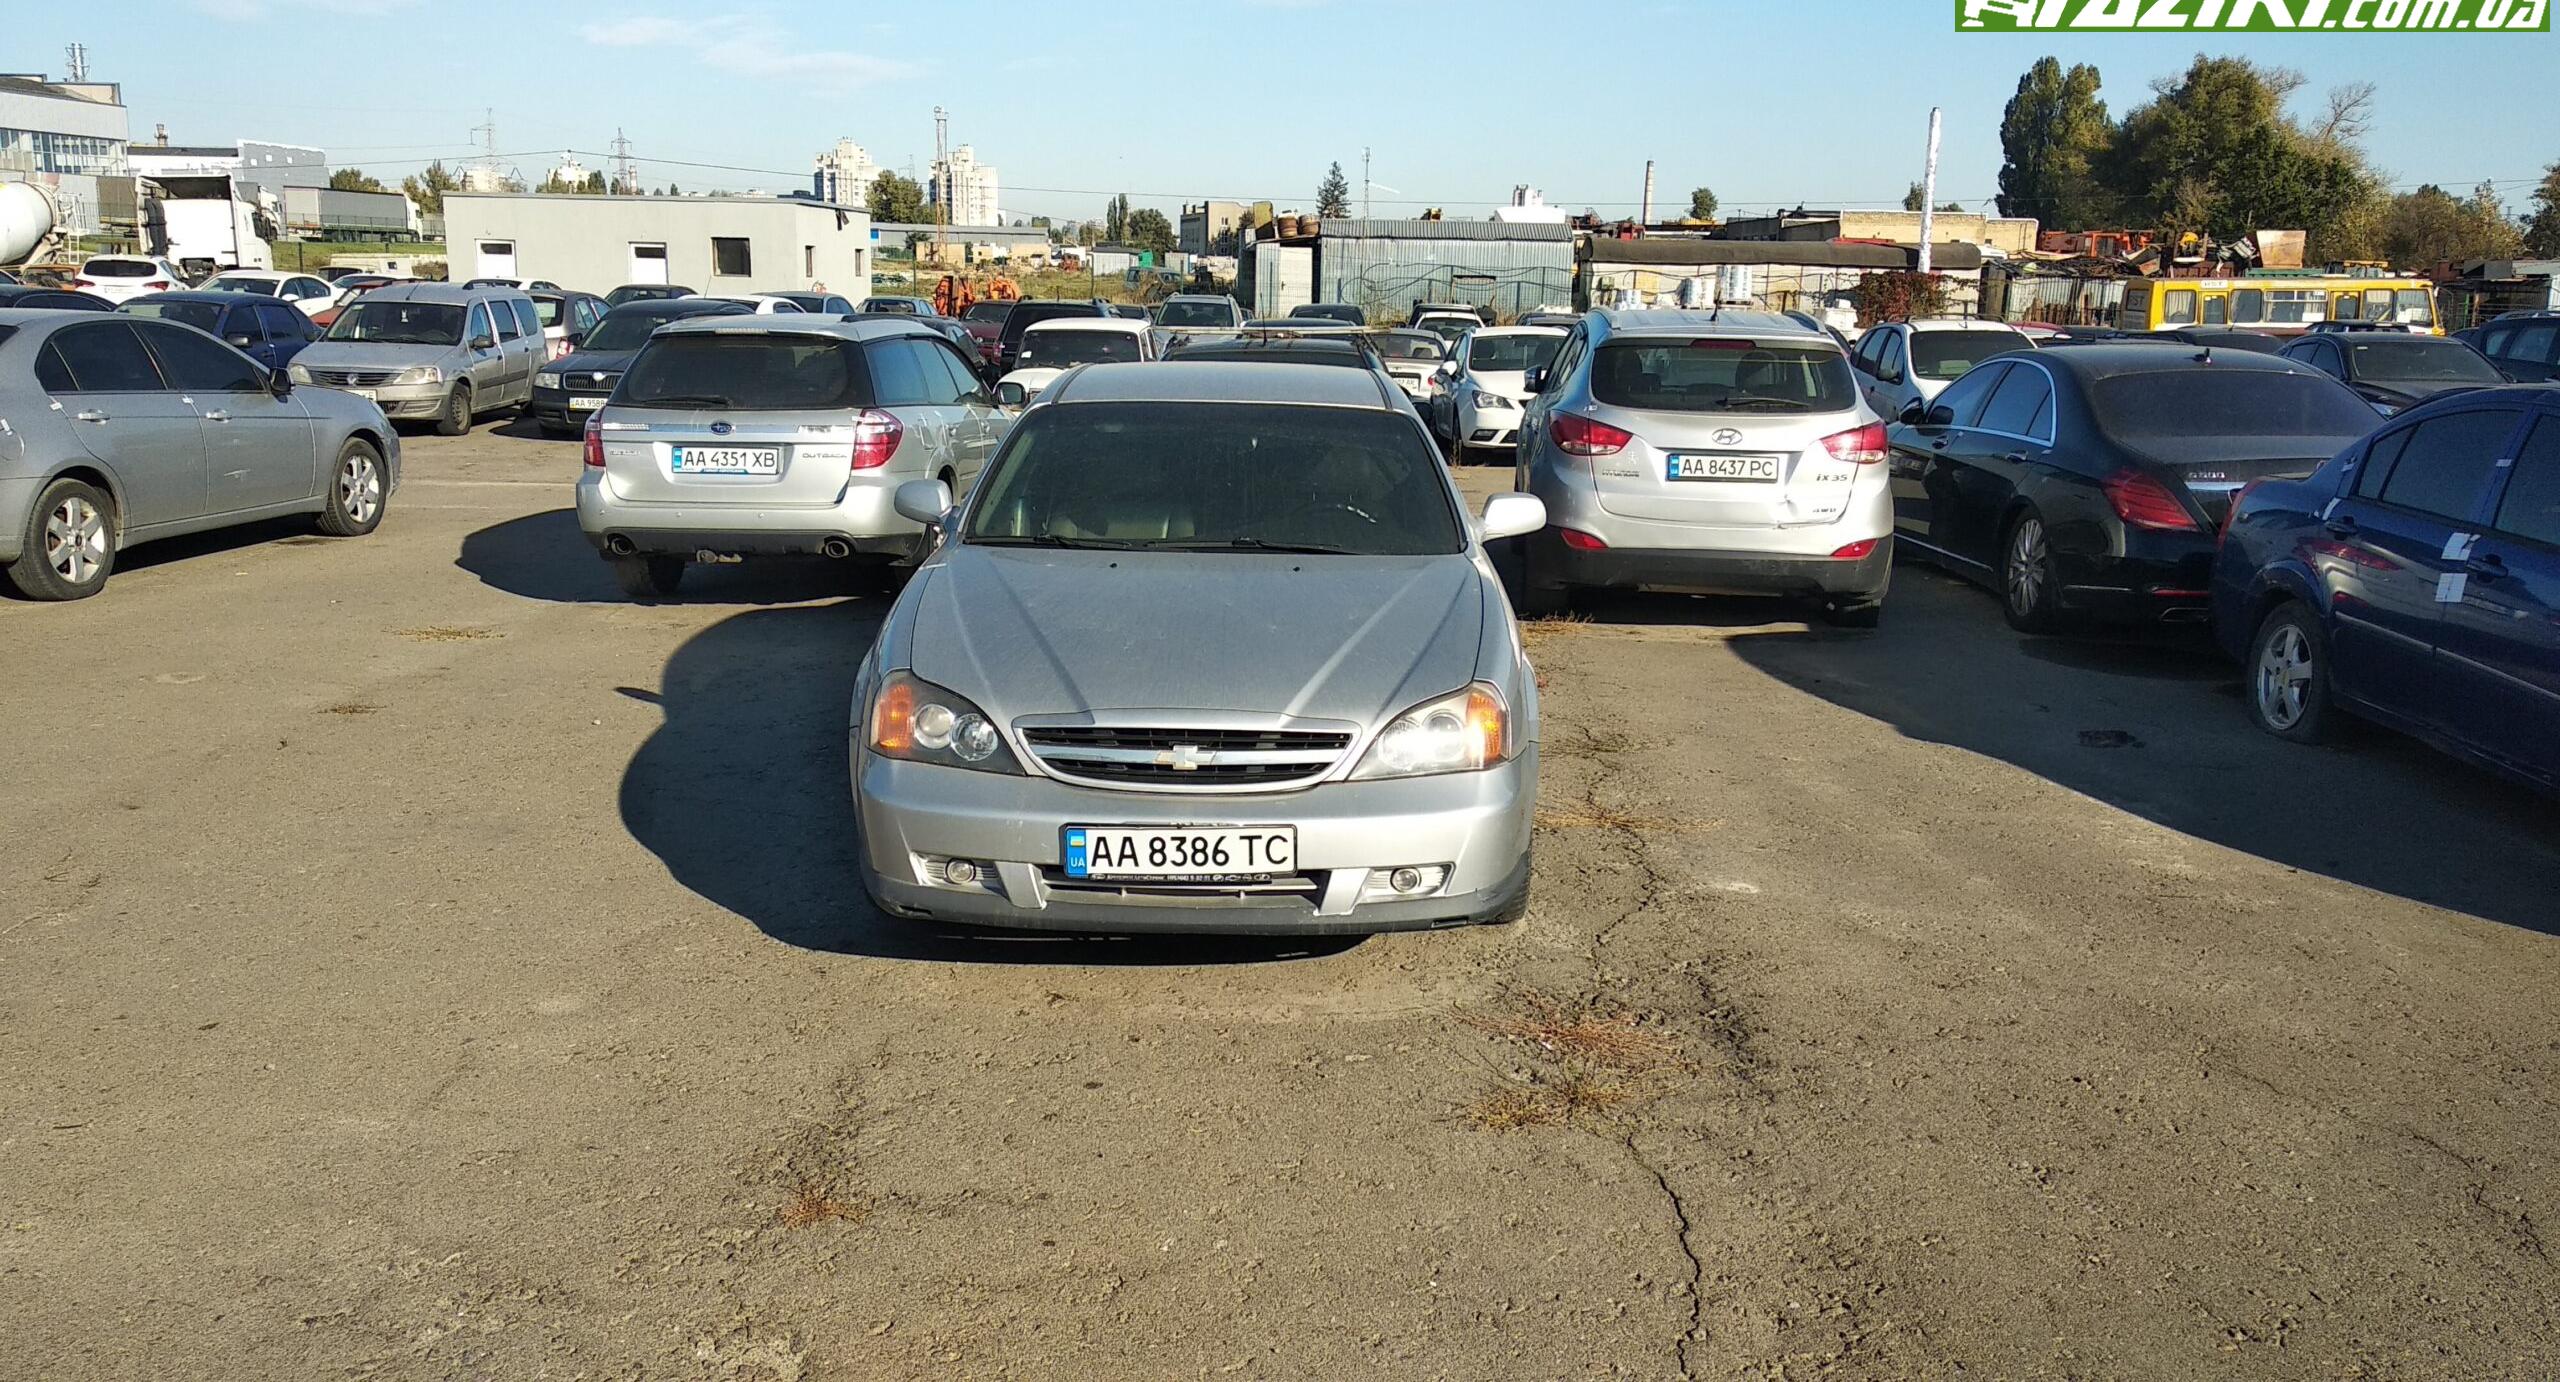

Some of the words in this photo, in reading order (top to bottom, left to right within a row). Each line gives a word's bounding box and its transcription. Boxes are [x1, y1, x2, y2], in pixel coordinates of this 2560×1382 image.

[684, 450, 706, 466] AA
[710, 451, 747, 467] 4351
[752, 452, 775, 468] XB
[1682, 458, 1704, 475] AA
[1709, 459, 1746, 475] 8437
[1749, 460, 1773, 476] PC
[1090, 836, 1140, 867] AA
[1148, 836, 1230, 867] 8386
[1239, 834, 1289, 866] TC
[1070, 857, 1086, 867] UA
